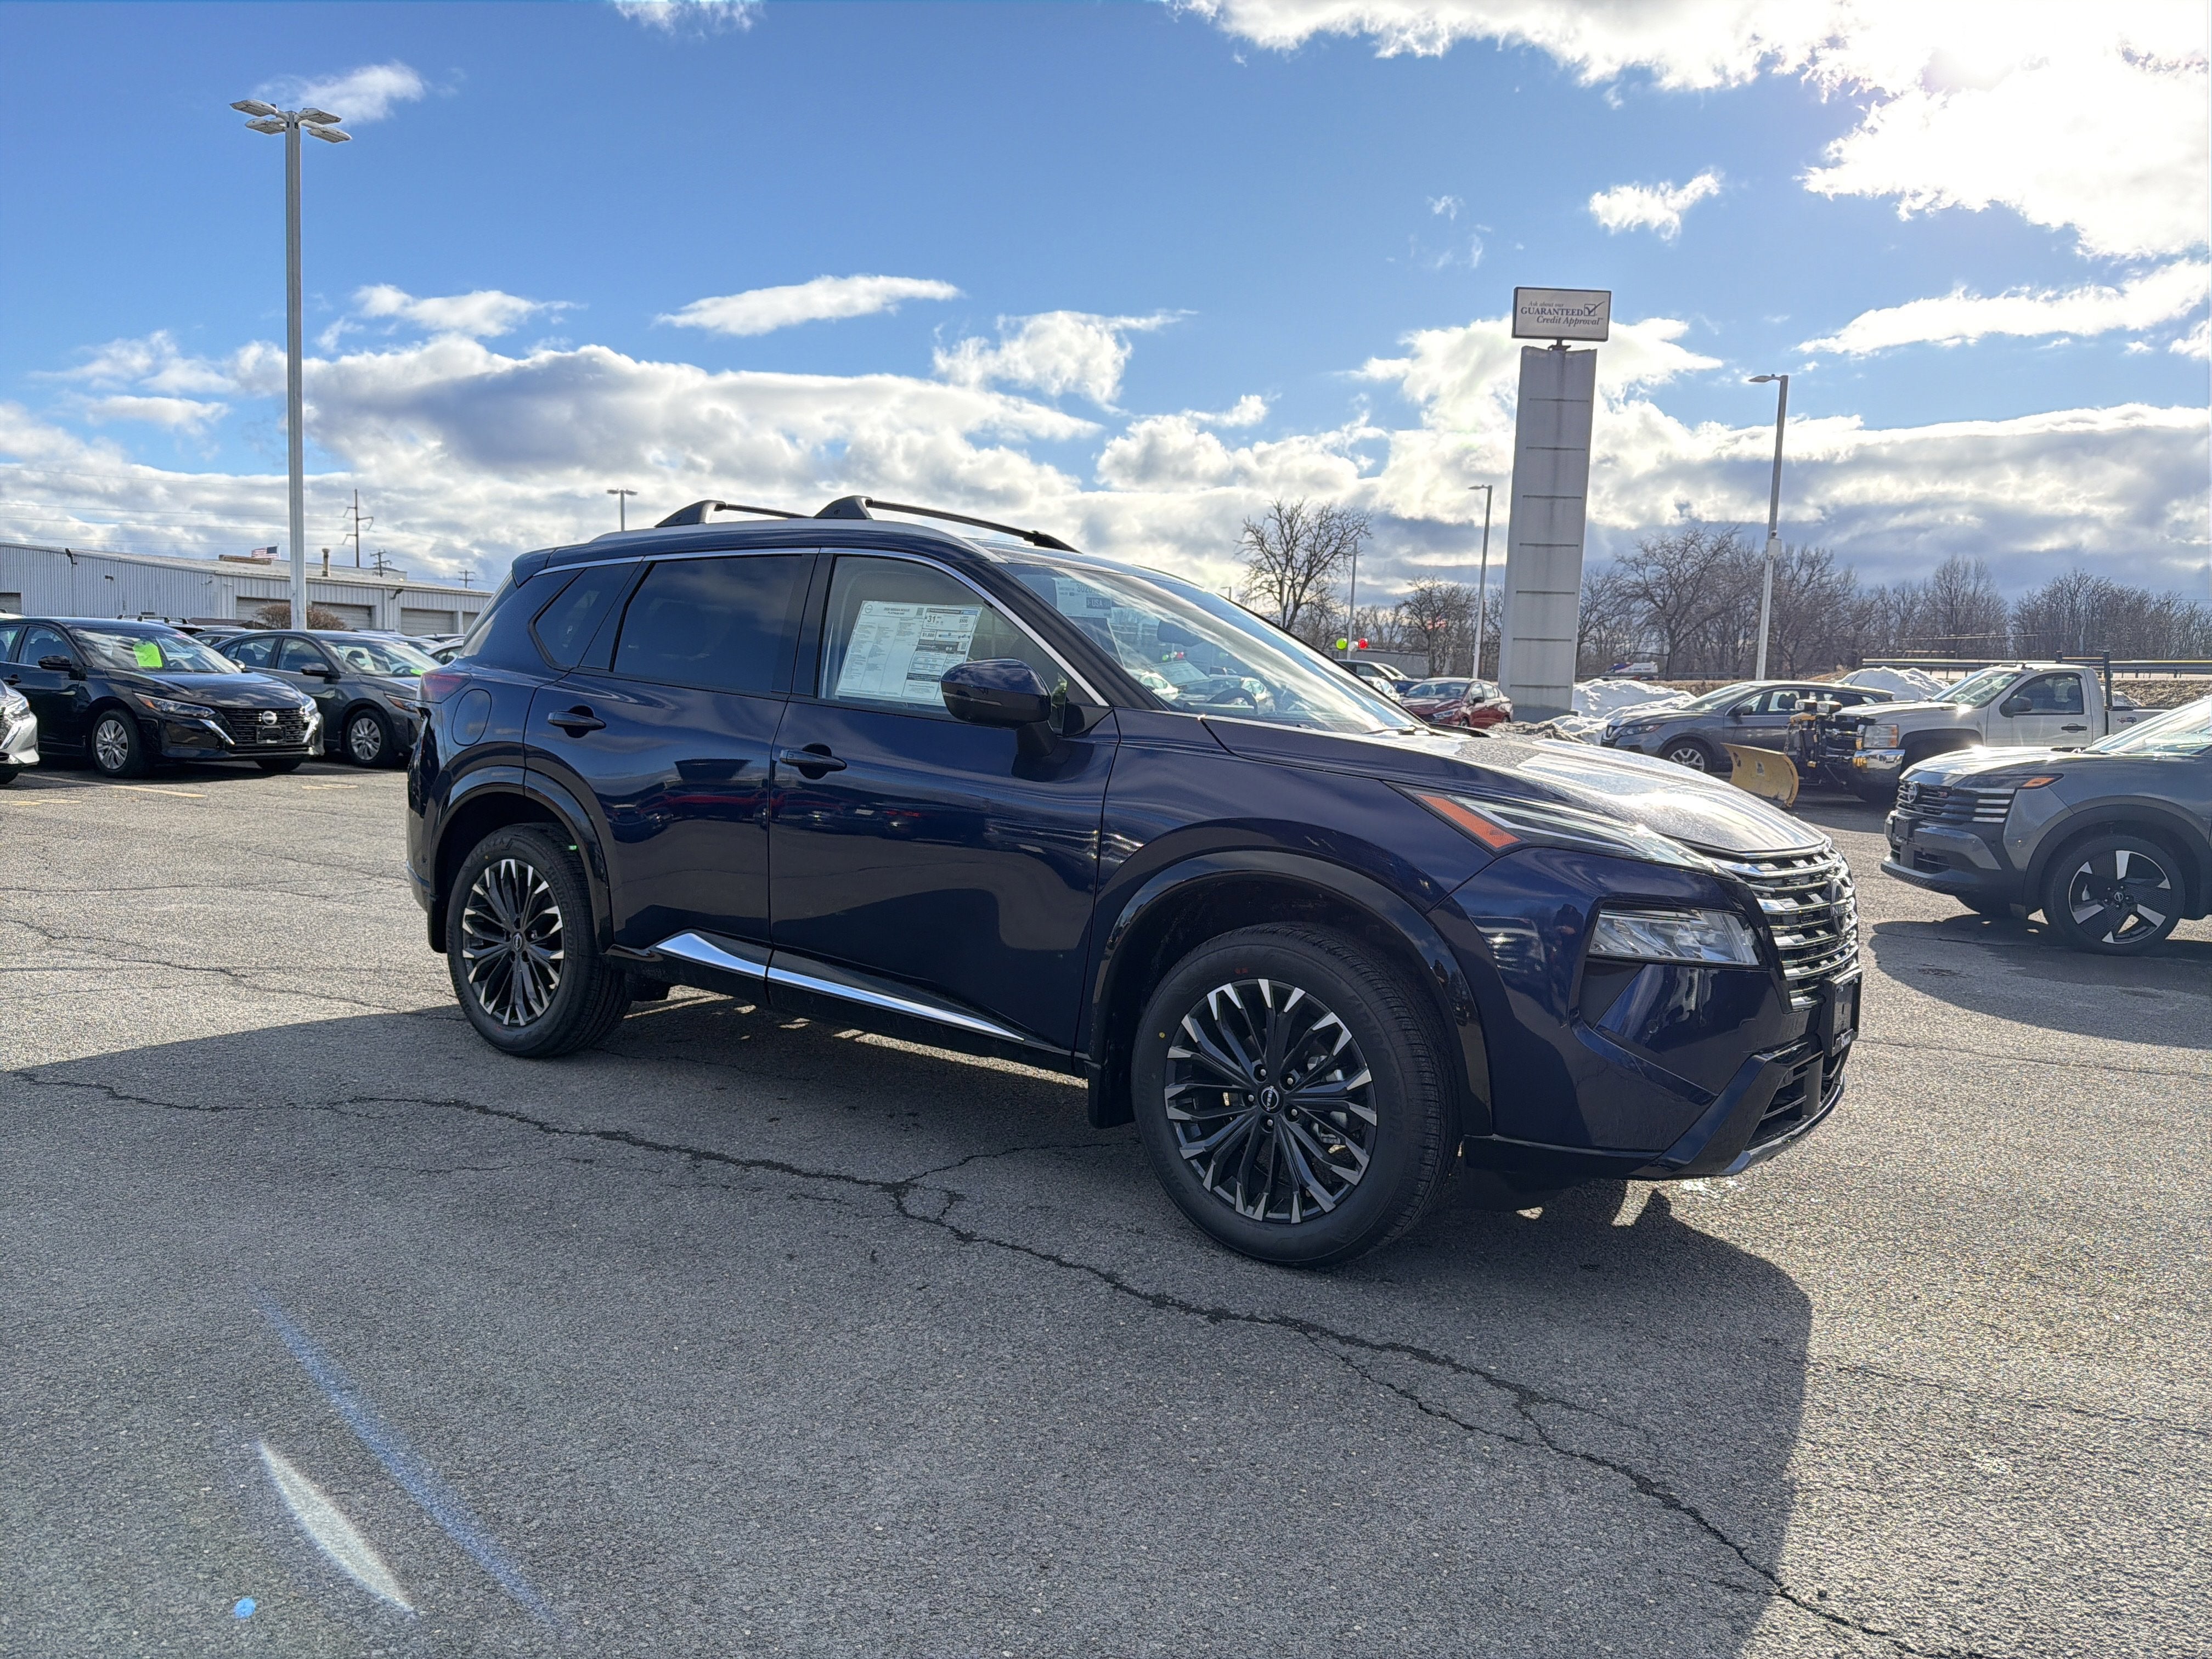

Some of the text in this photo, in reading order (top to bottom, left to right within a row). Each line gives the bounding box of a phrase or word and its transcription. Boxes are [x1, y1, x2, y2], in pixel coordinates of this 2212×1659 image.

[1520, 307, 1583, 317] GUARANTEED
[1537, 315, 1601, 328] Credit Approval
[927, 615, 936, 623] 31
